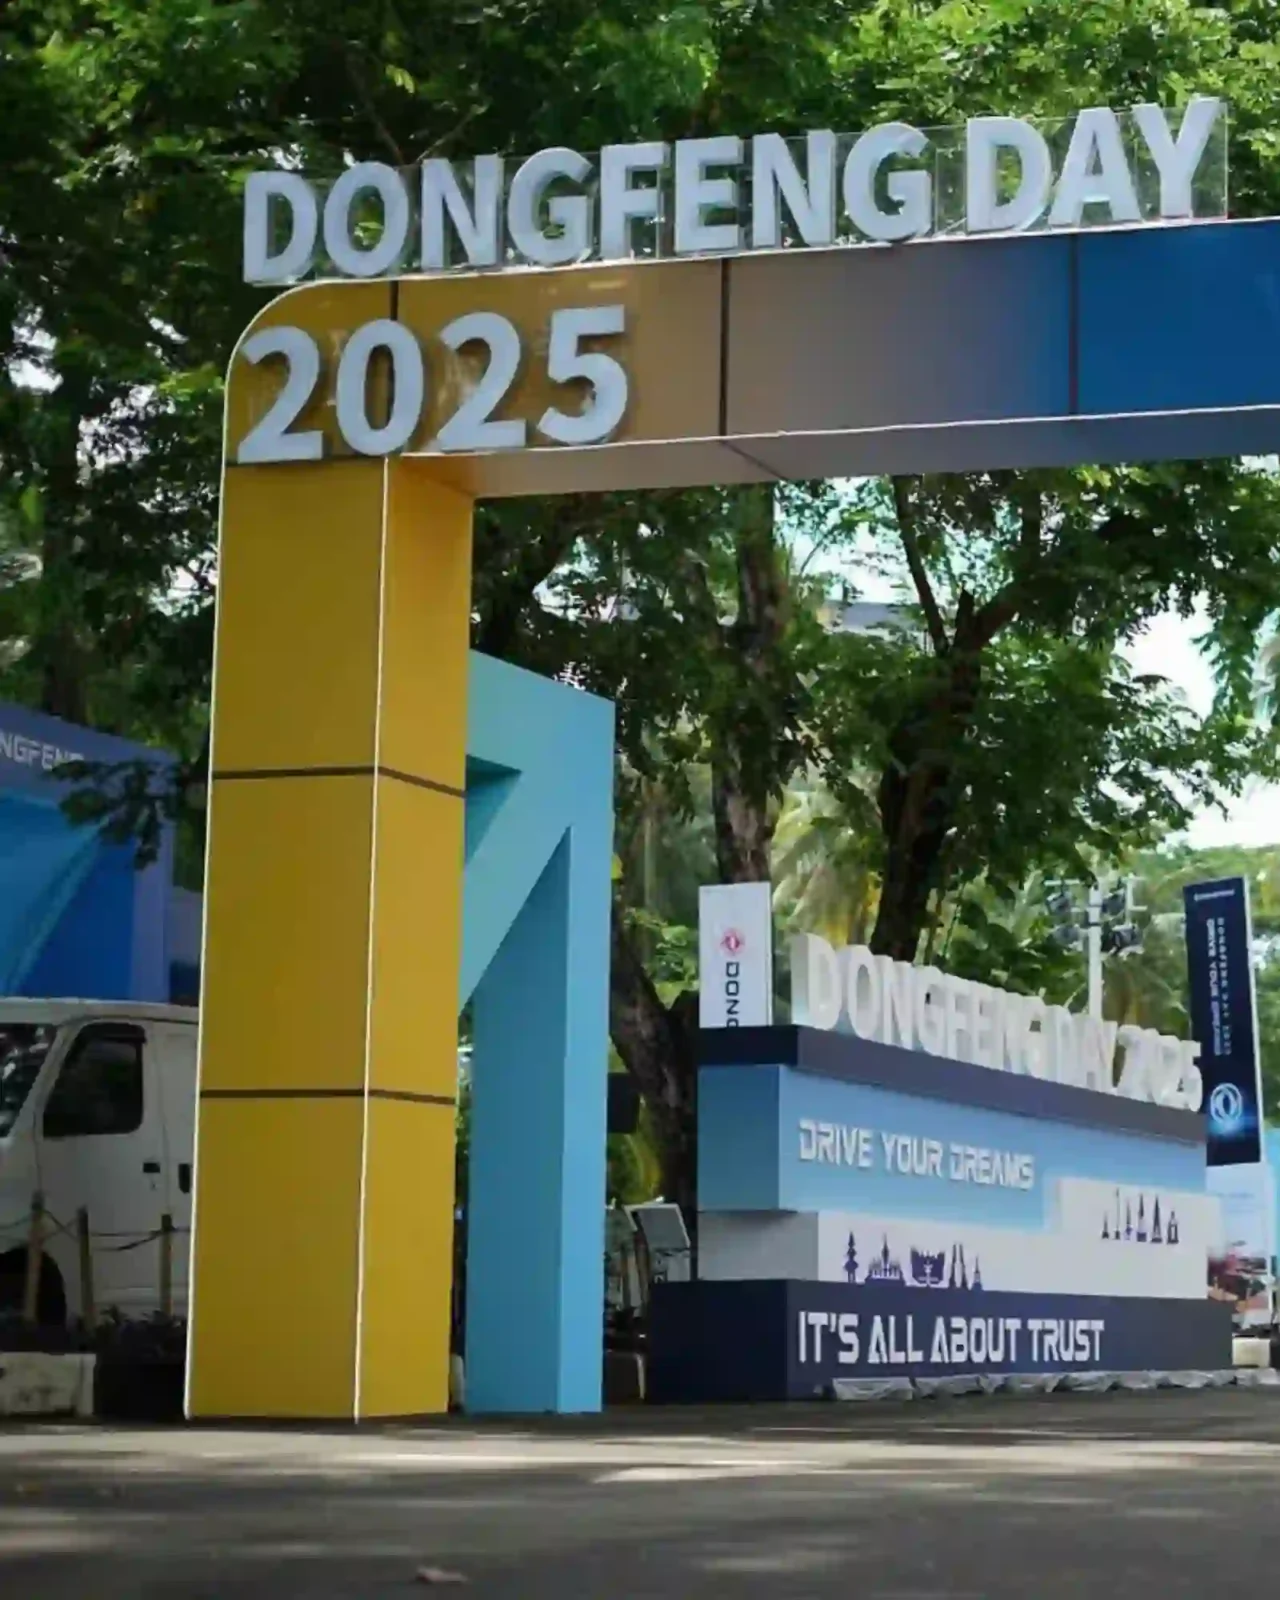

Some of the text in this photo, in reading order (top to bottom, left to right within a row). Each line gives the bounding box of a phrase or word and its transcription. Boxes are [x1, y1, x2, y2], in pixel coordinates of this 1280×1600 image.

[243, 96, 1221, 285] DONGFENG DAY
[238, 304, 629, 464] 2025
[791, 932, 1203, 1112] DONGFENG DAY 2025
[799, 1118, 1035, 1191] DRIVE YOUR DREAMS
[799, 1311, 1105, 1364] IT'S ALL ABOUT TRUST
